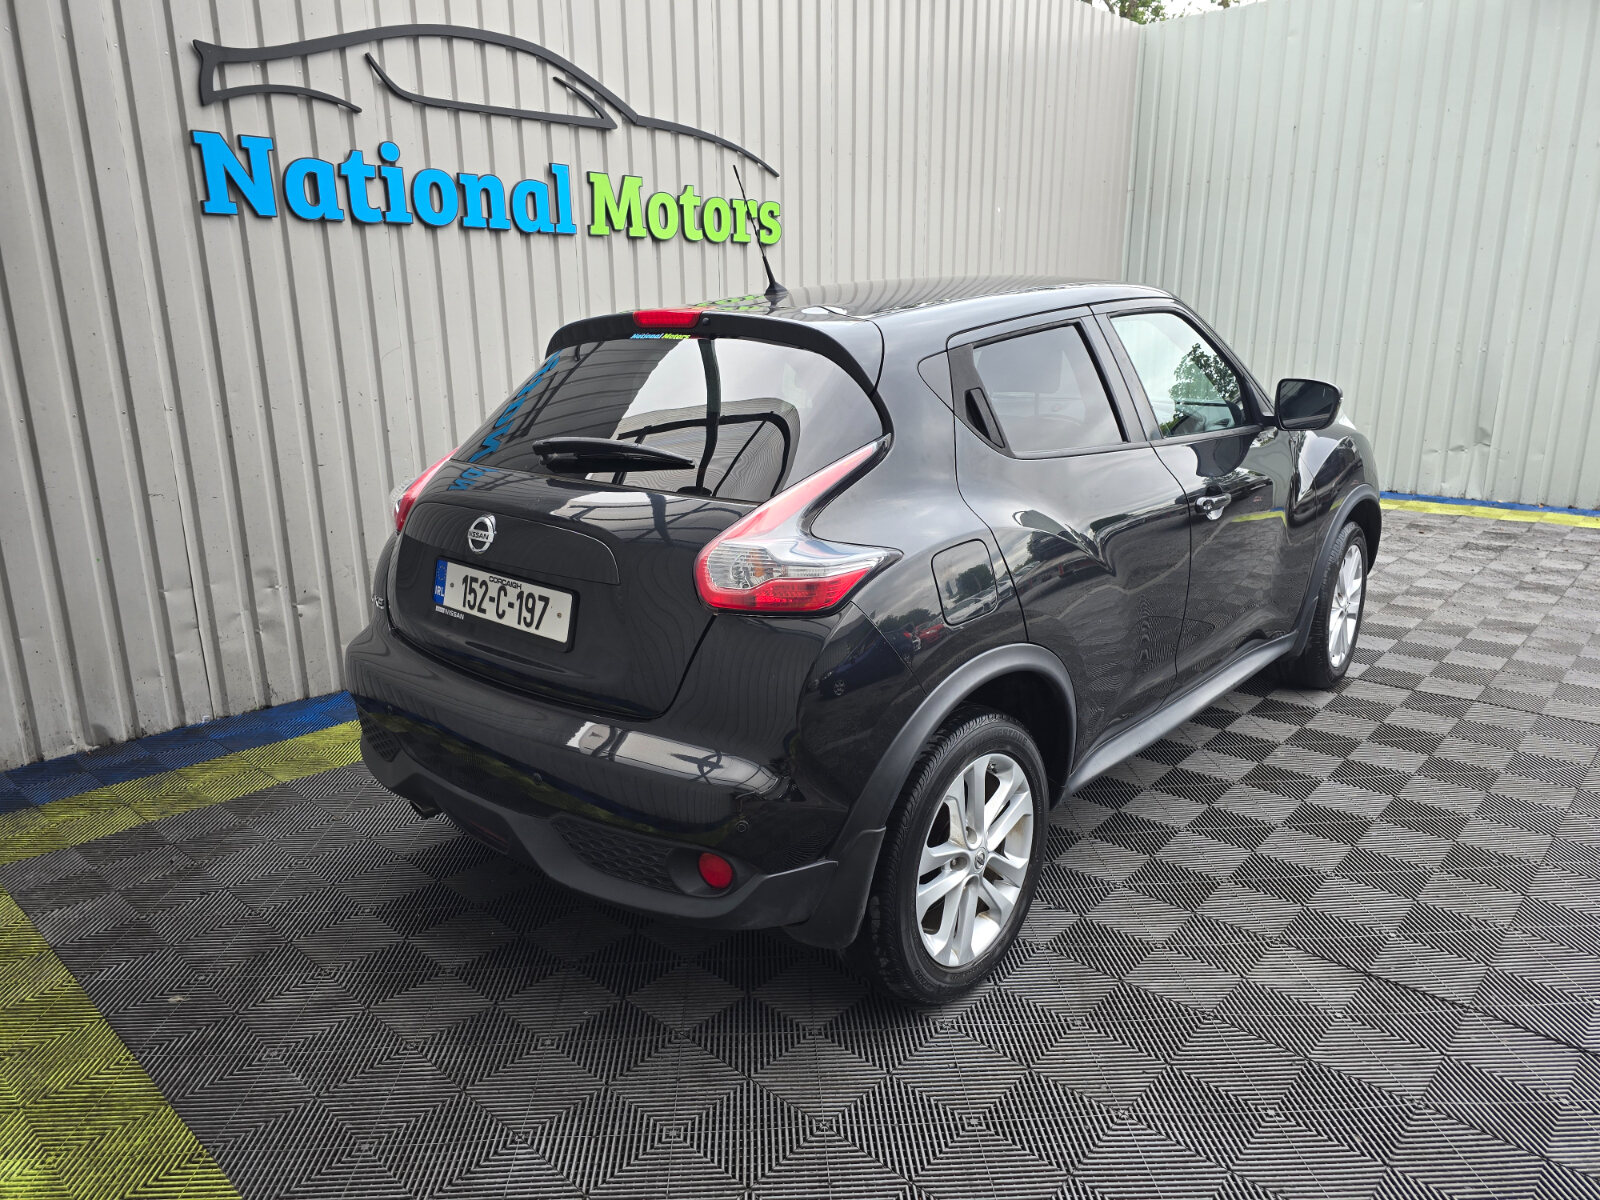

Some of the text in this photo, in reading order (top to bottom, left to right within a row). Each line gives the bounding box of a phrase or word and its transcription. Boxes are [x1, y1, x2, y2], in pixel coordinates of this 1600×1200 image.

[191, 130, 782, 245] National Motors
[469, 530, 490, 540] NISSAN
[489, 575, 522, 590] CORCAIGH
[434, 585, 445, 597] IRL
[462, 574, 550, 630] 152-C-197
[445, 608, 465, 620] NISSAN
